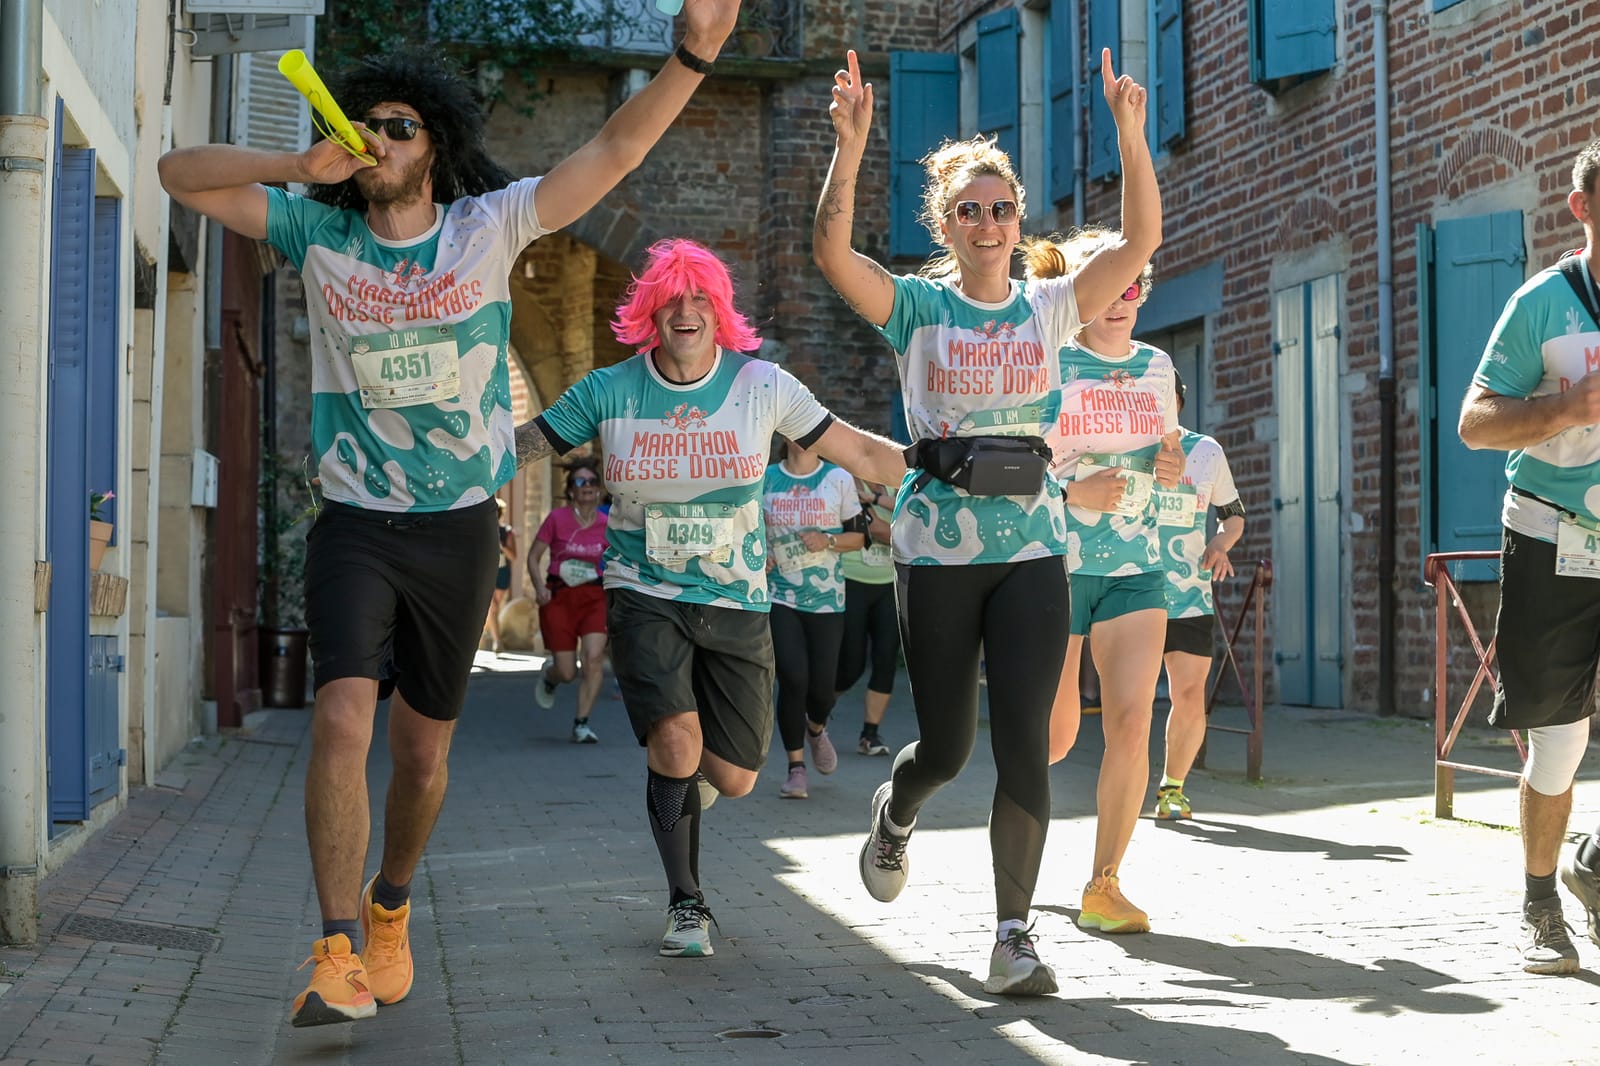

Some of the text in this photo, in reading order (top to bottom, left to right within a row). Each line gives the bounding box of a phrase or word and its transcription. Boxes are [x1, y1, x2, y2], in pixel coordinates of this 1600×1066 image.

[389, 331, 419, 349] 10 KM
[948, 339, 1045, 367] MARATHON
[380, 351, 432, 382] 4351
[927, 360, 994, 395] BRESSE
[1081, 388, 1158, 413] MARATHON
[993, 409, 1019, 425] 10 KM
[1060, 412, 1123, 437] BRESSE
[630, 430, 740, 459] MARATHON
[606, 452, 764, 482] BRESSE DOMBES
[1109, 455, 1132, 469] 10 KM
[680, 504, 704, 518] 10 KM
[771, 498, 826, 512] MARATHON
[800, 510, 837, 526] DOMBES
[667, 523, 713, 545] 4349
